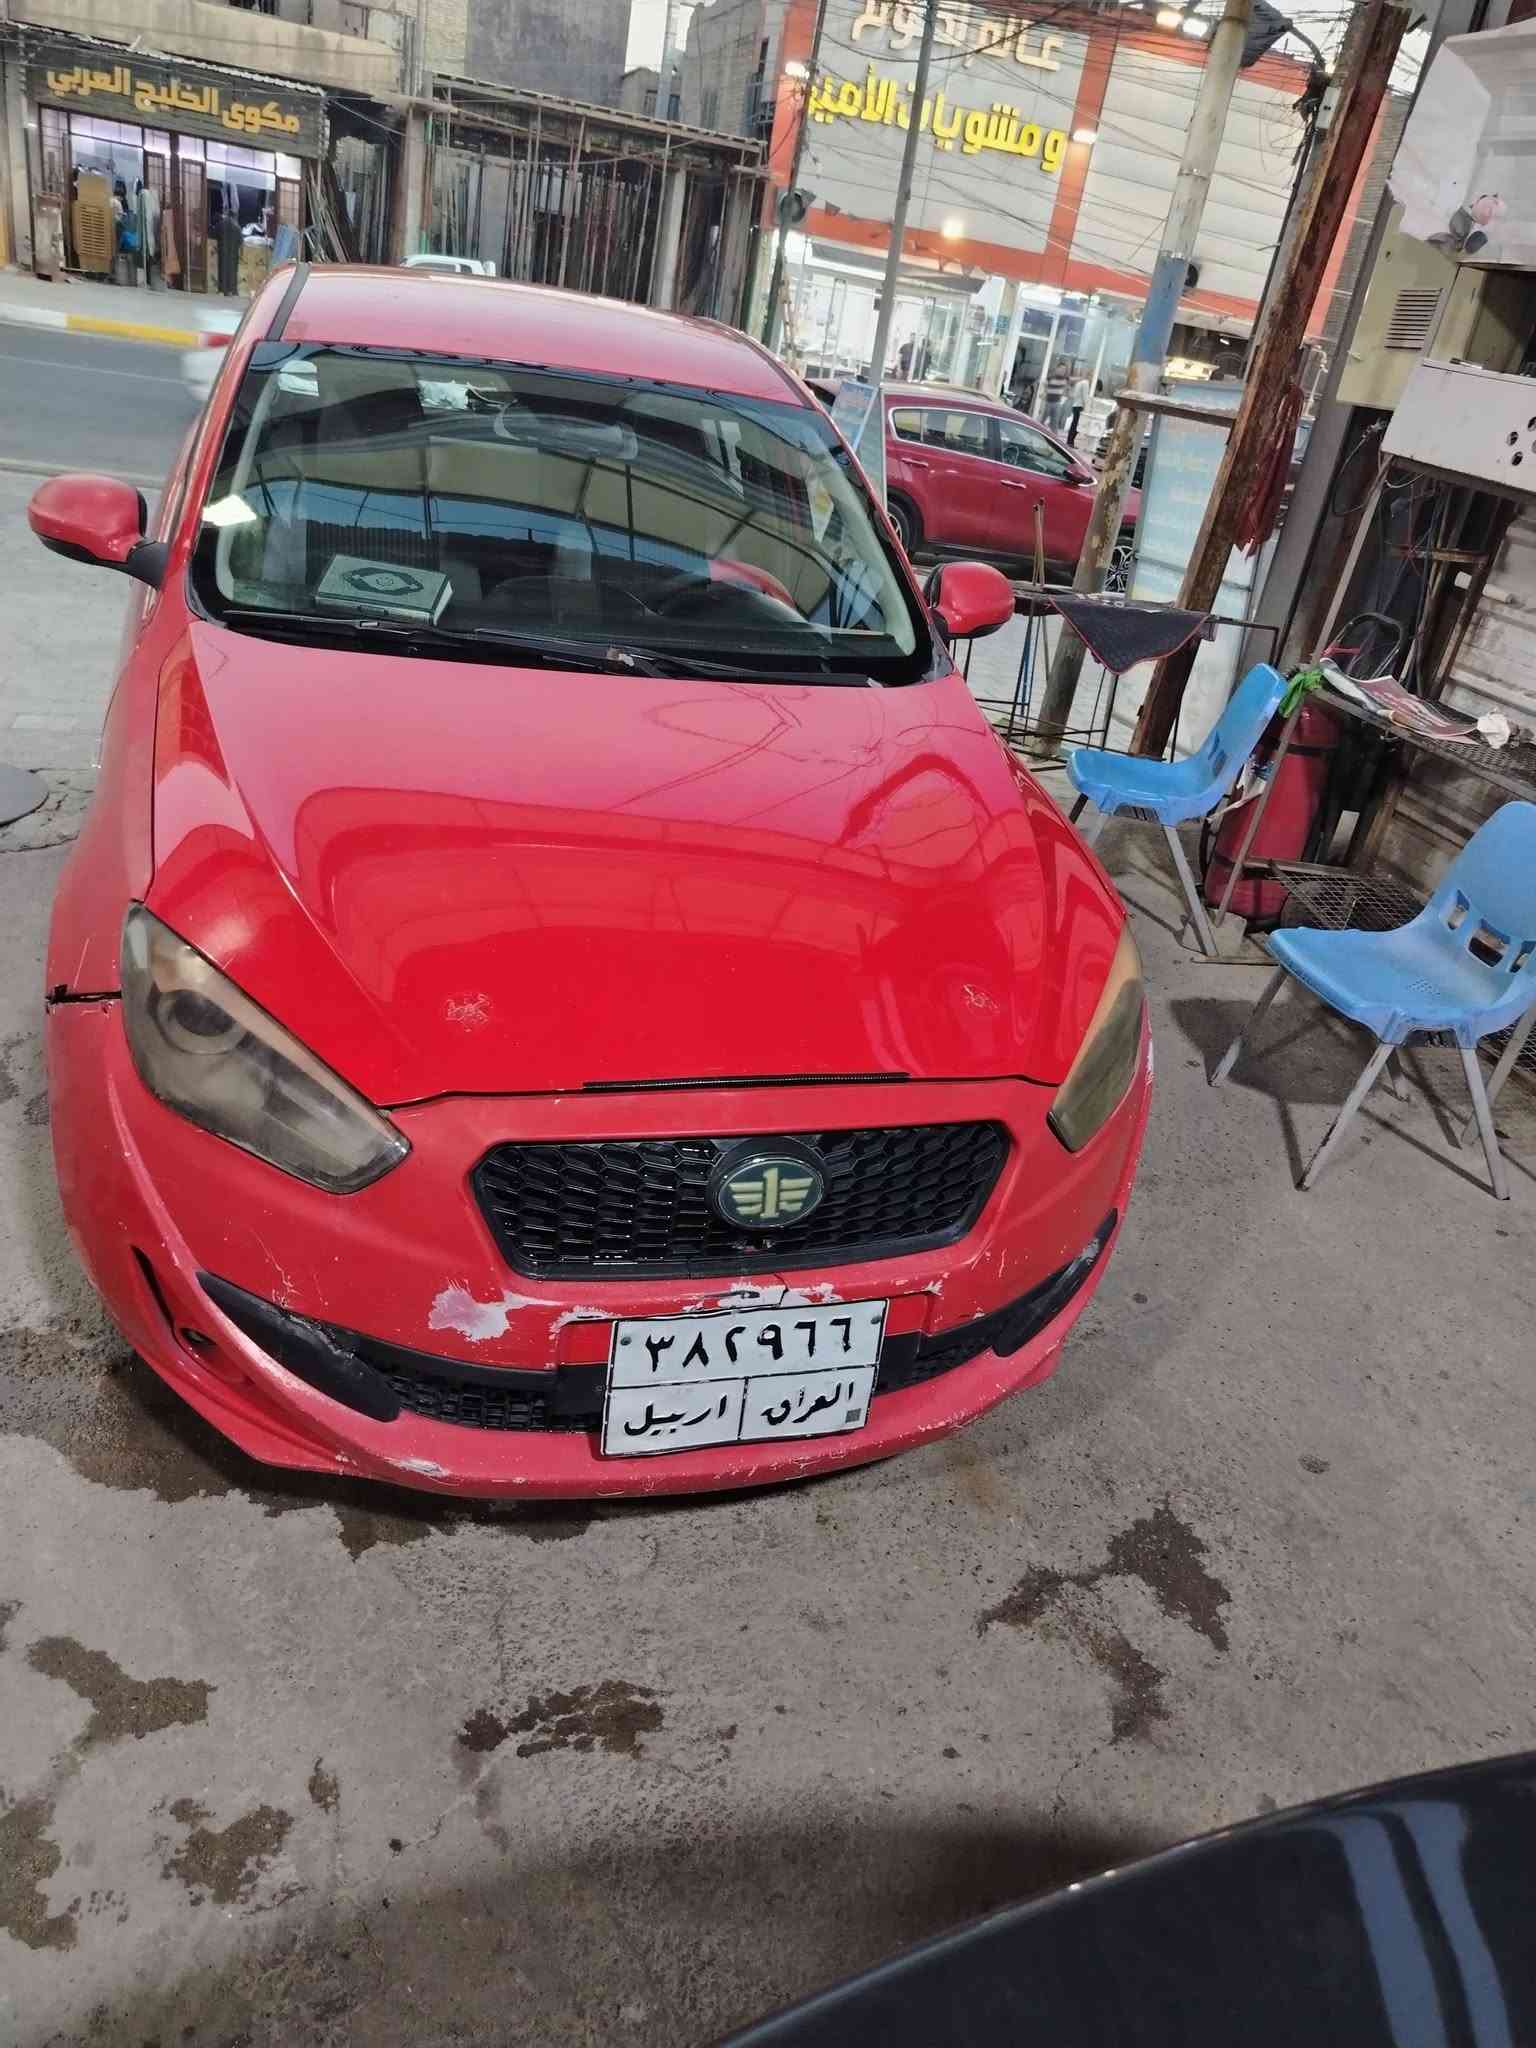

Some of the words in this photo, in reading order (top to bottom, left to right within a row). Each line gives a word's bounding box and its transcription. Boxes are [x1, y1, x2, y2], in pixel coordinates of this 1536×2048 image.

[47, 66, 131, 96] العربي
[134, 78, 219, 115] الخليج
[645, 1316, 853, 1373] ٣٨٢٩٦٦
[624, 1395, 728, 1437] اربيل
[761, 1381, 854, 1427] العراق
